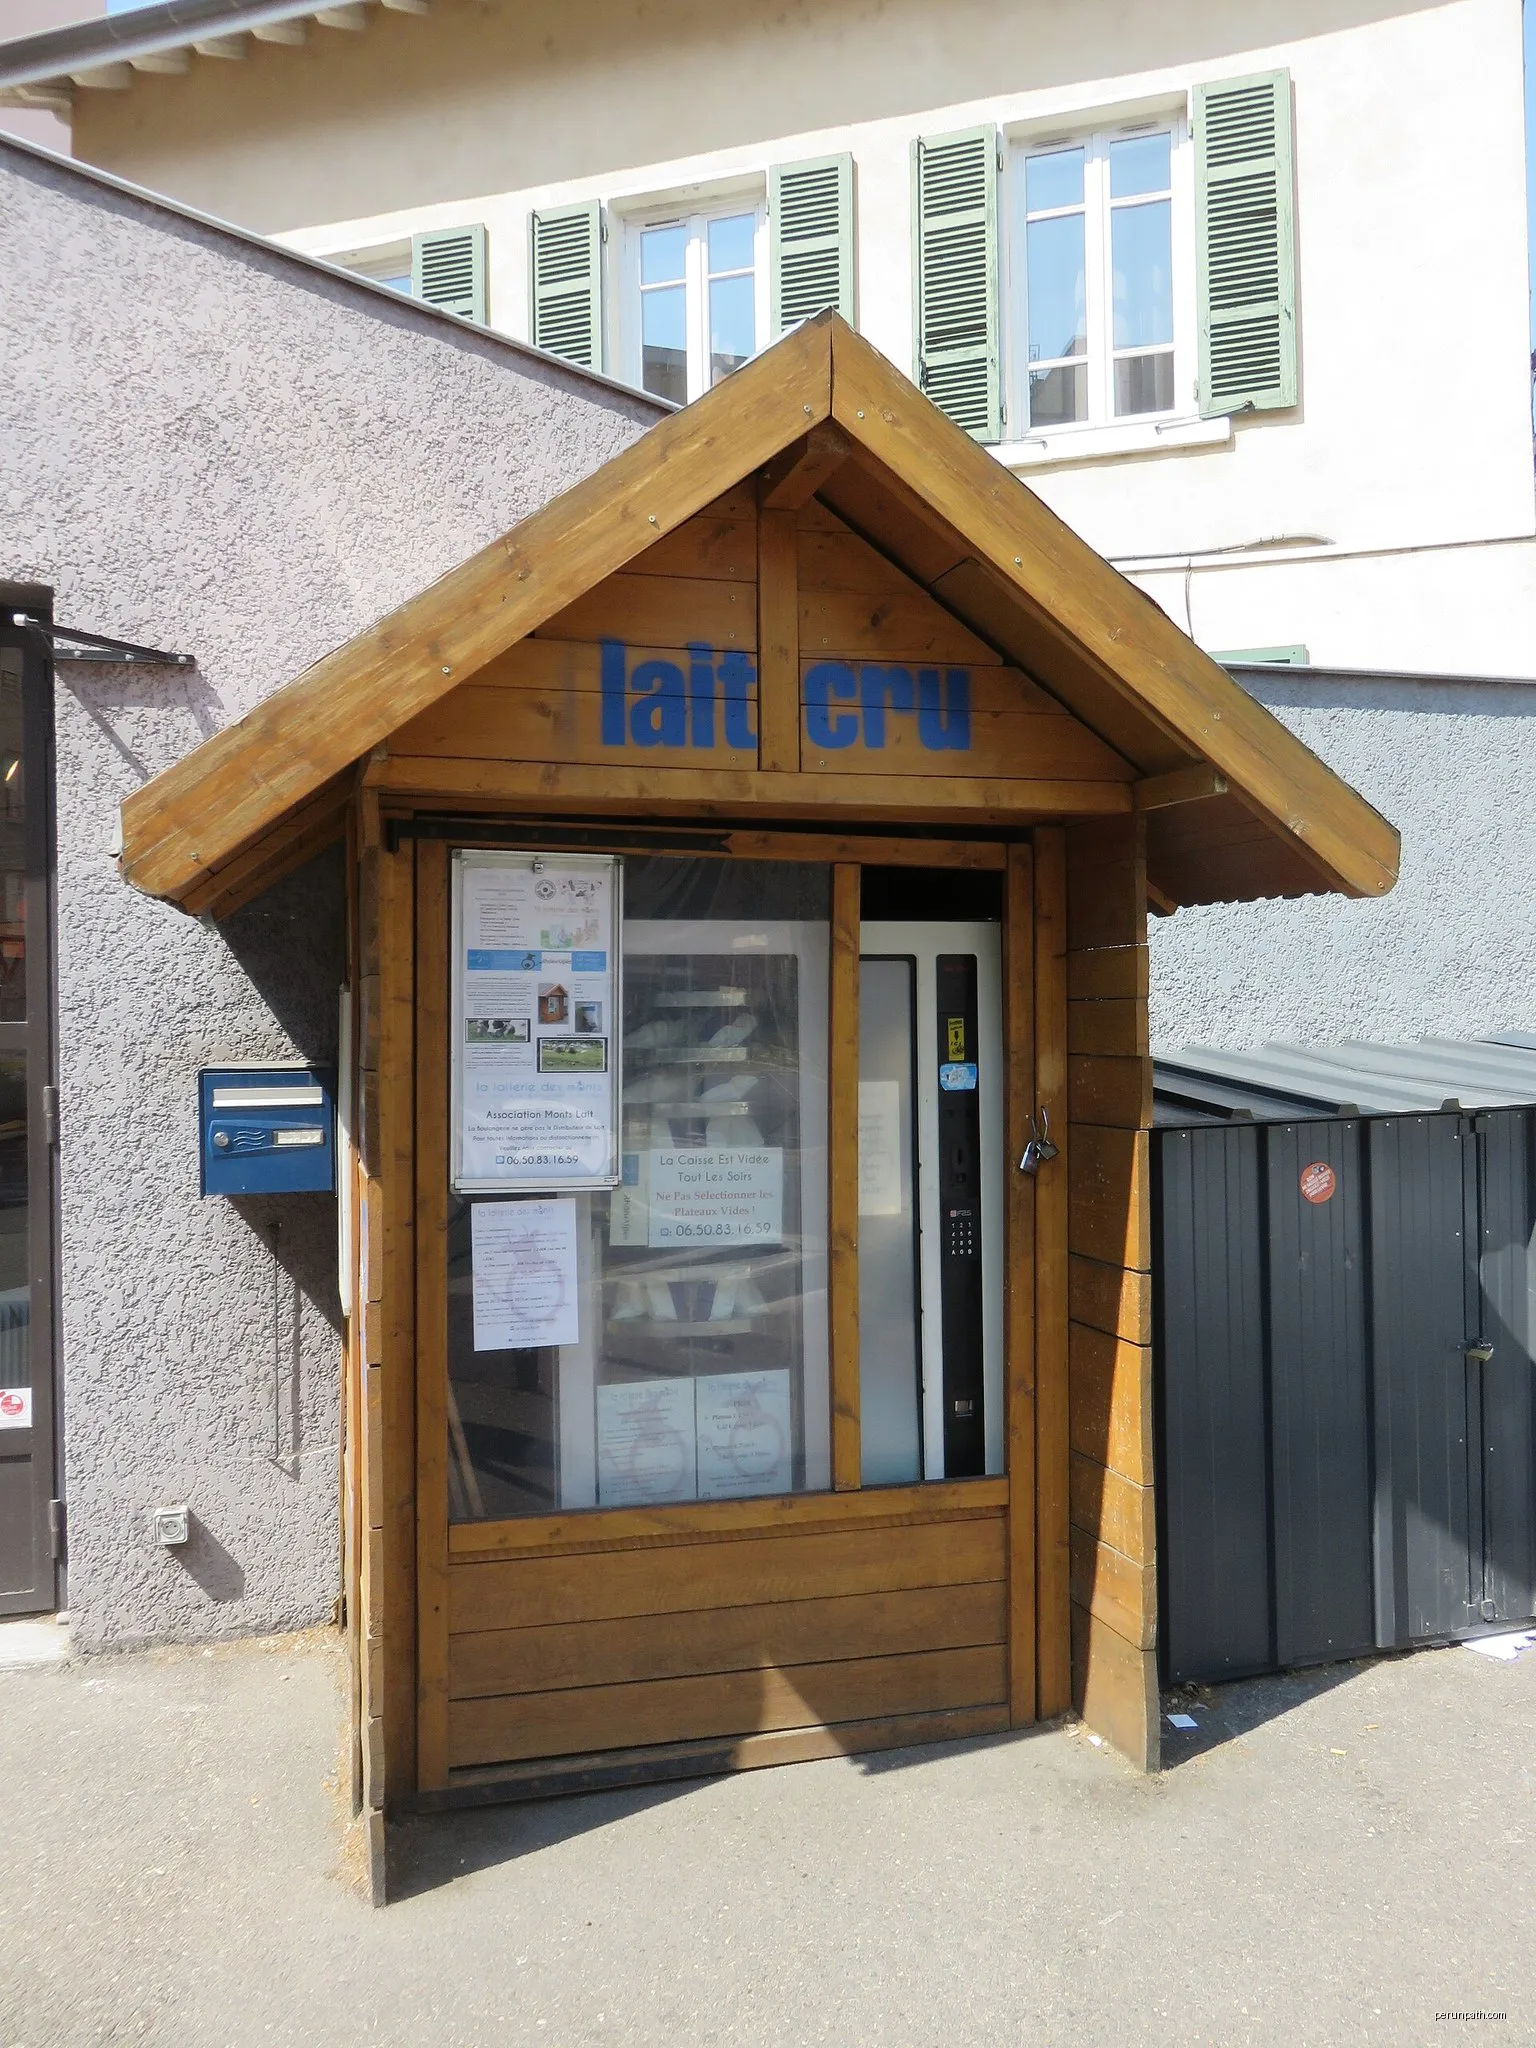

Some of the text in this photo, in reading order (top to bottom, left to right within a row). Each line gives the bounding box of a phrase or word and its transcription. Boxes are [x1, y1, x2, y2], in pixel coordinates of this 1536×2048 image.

[599, 638, 971, 751] lait cru
[486, 1110, 593, 1119] Association Monts Lait
[506, 1155, 579, 1165] 06.50.83.16.59
[660, 1154, 770, 1166] La Caisse Est Vidée
[678, 1171, 753, 1183] Tout Les Soirs
[656, 1192, 672, 1201] Ne
[673, 1191, 691, 1201] Pas
[674, 1206, 718, 1217] Plateaux
[721, 1206, 749, 1216] Vides
[675, 1222, 771, 1237] 06.50.83.16.59
